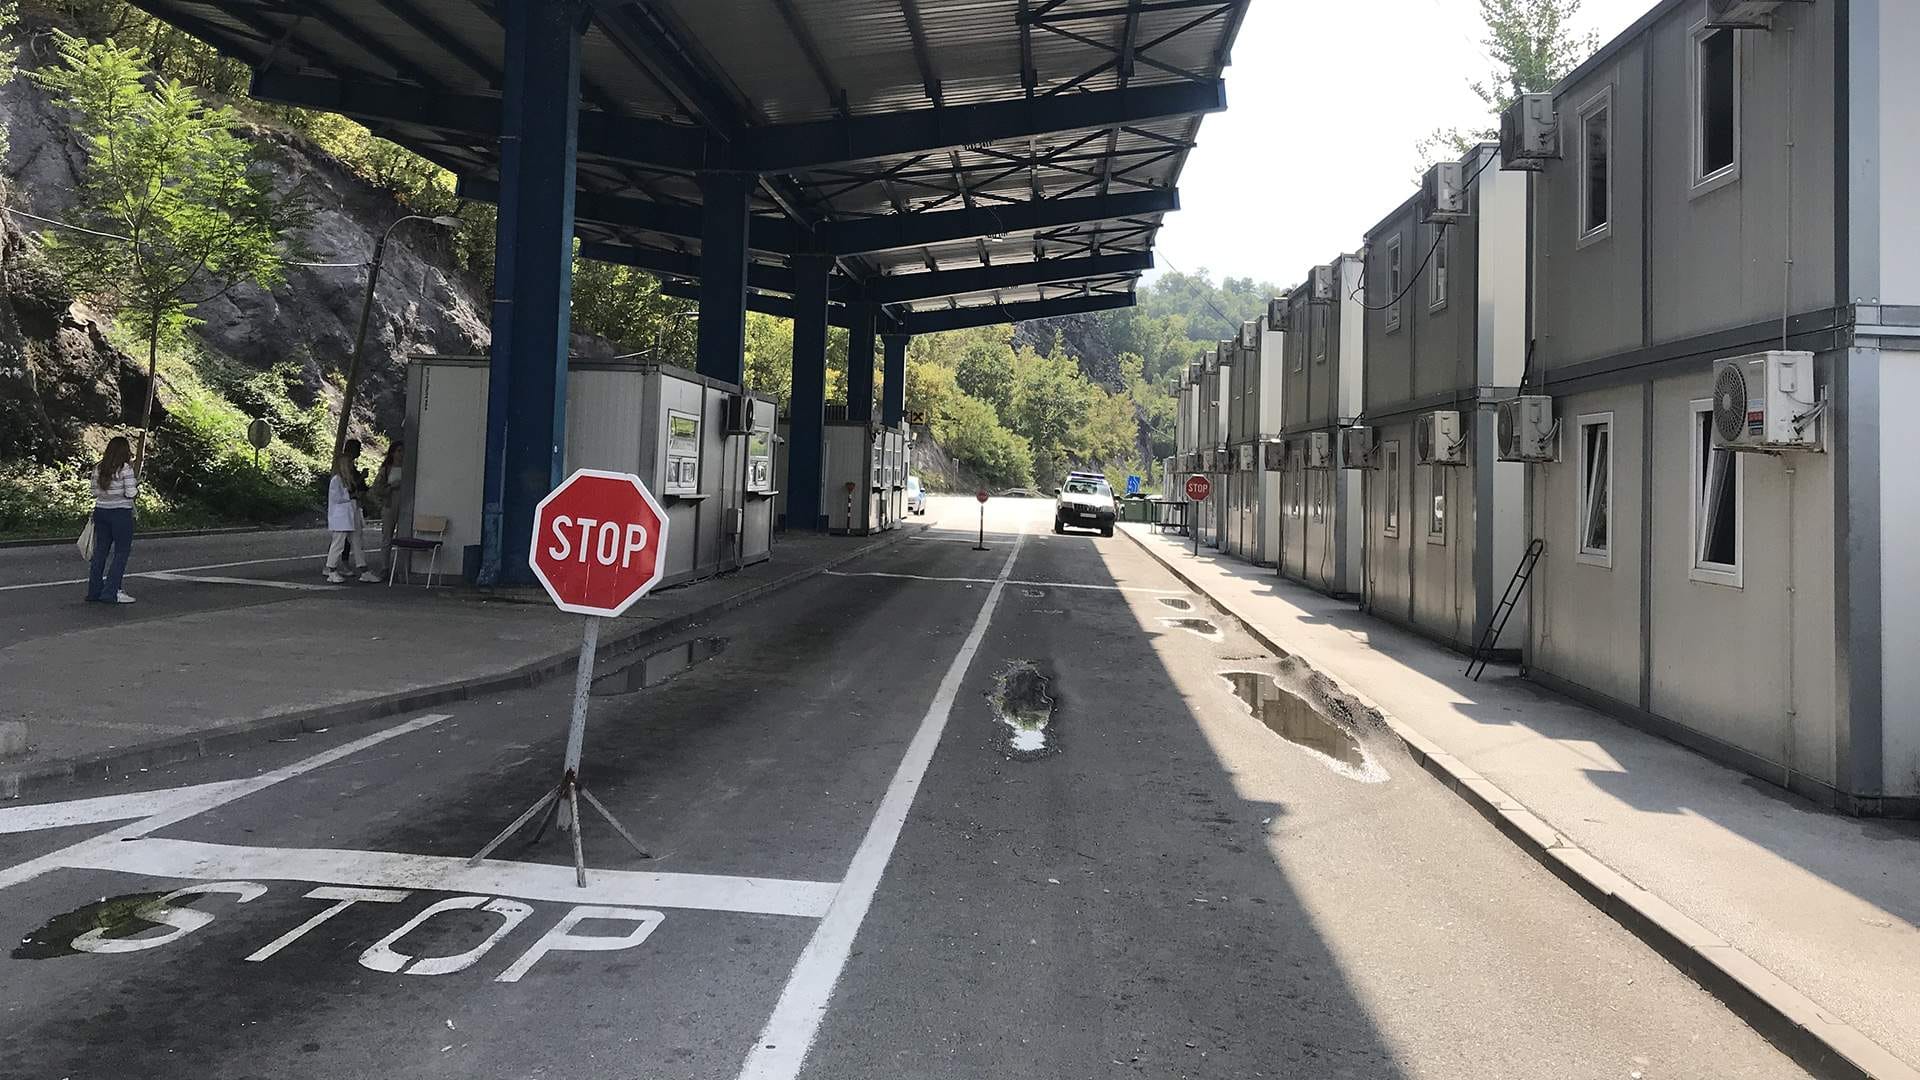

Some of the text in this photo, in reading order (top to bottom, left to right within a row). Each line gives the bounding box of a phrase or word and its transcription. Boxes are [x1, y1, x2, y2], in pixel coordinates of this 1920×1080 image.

[1188, 483, 1208, 493] STOP
[548, 515, 648, 568] STOP
[70, 881, 667, 983] STOP
